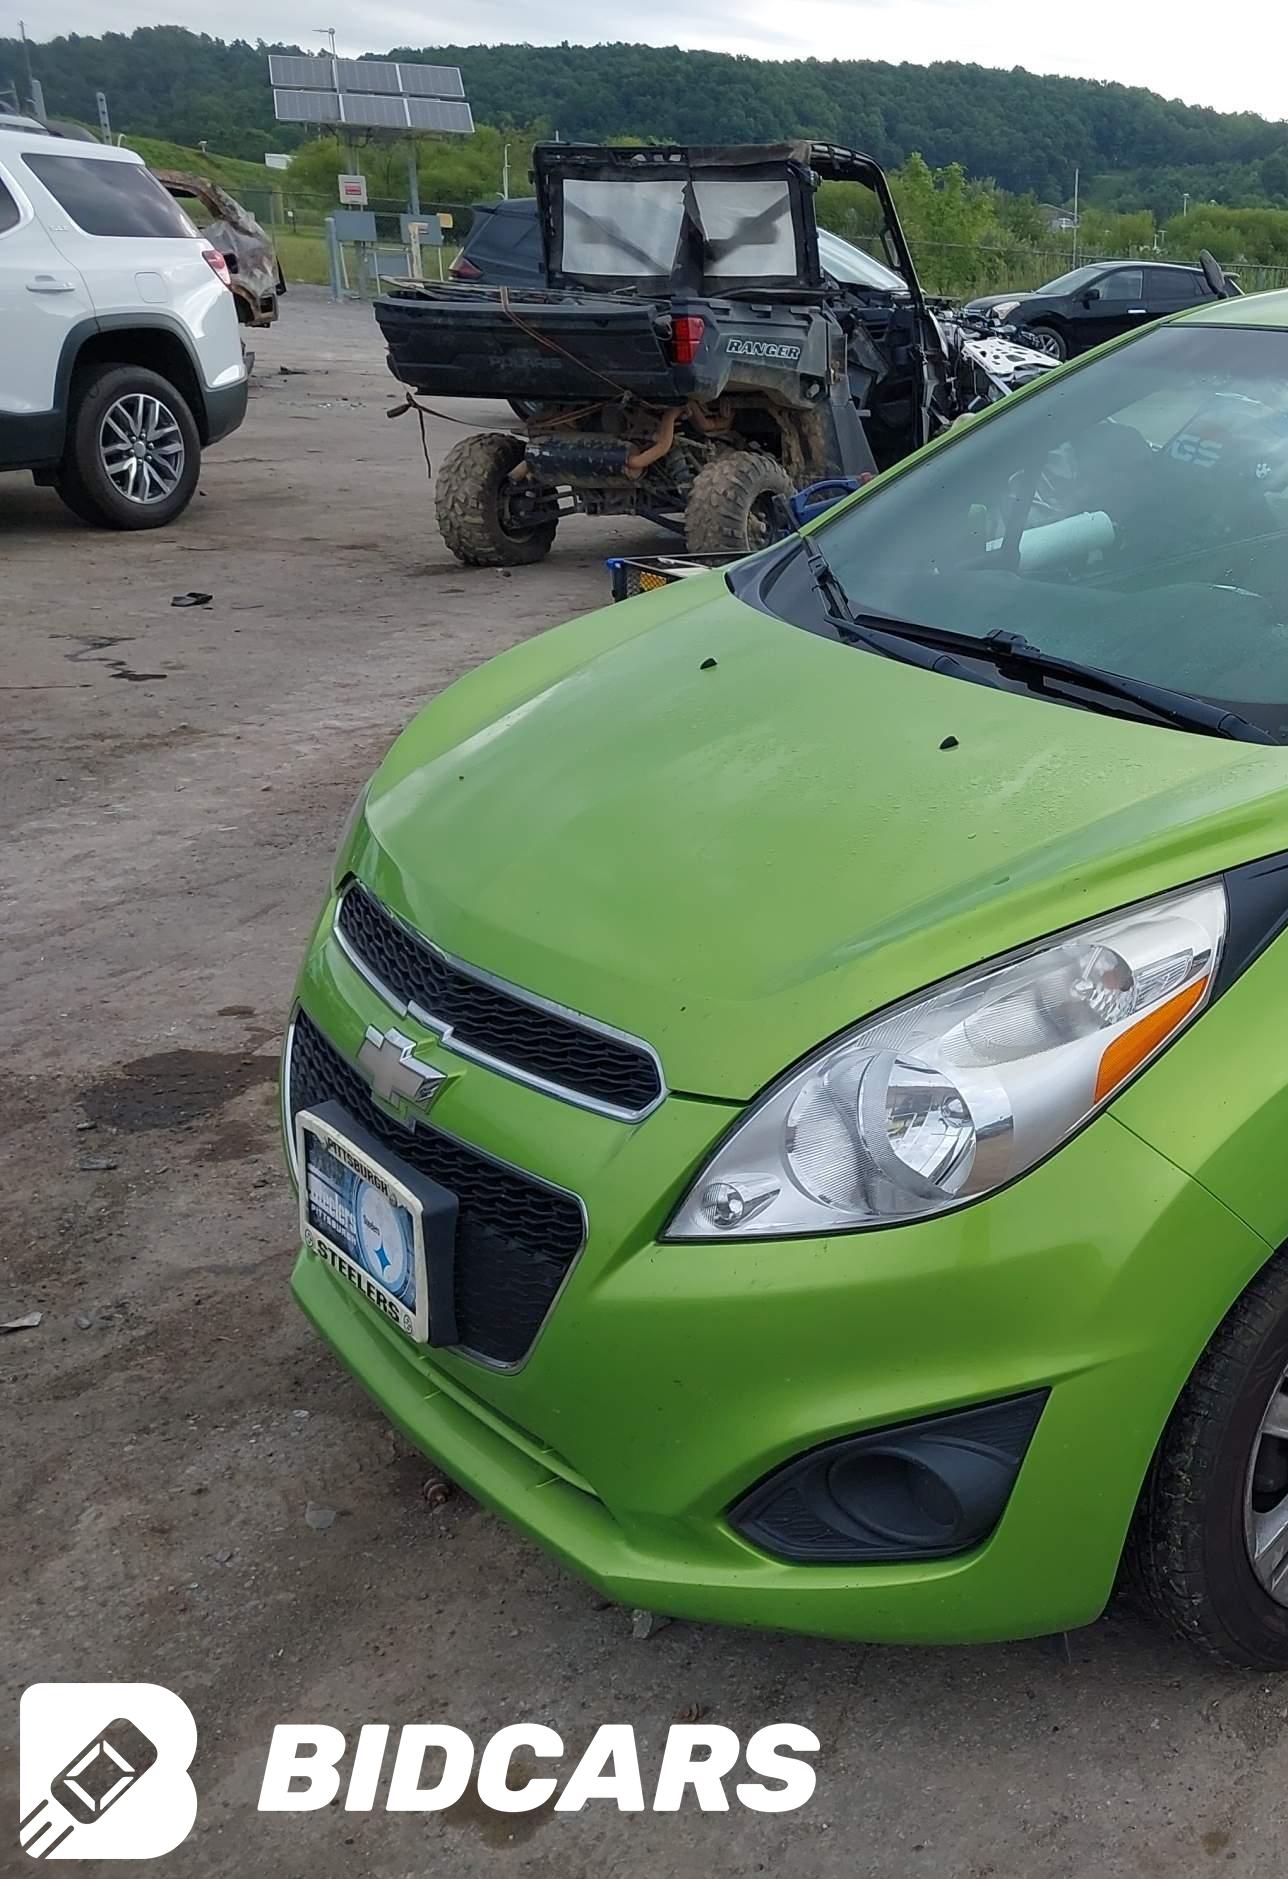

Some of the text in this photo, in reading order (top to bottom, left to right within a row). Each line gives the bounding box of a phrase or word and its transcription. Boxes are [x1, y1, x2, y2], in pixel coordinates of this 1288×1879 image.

[726, 339, 800, 359] RANGER
[327, 1136, 388, 1196] PITTSBURGH
[317, 1239, 400, 1323] STEELERS
